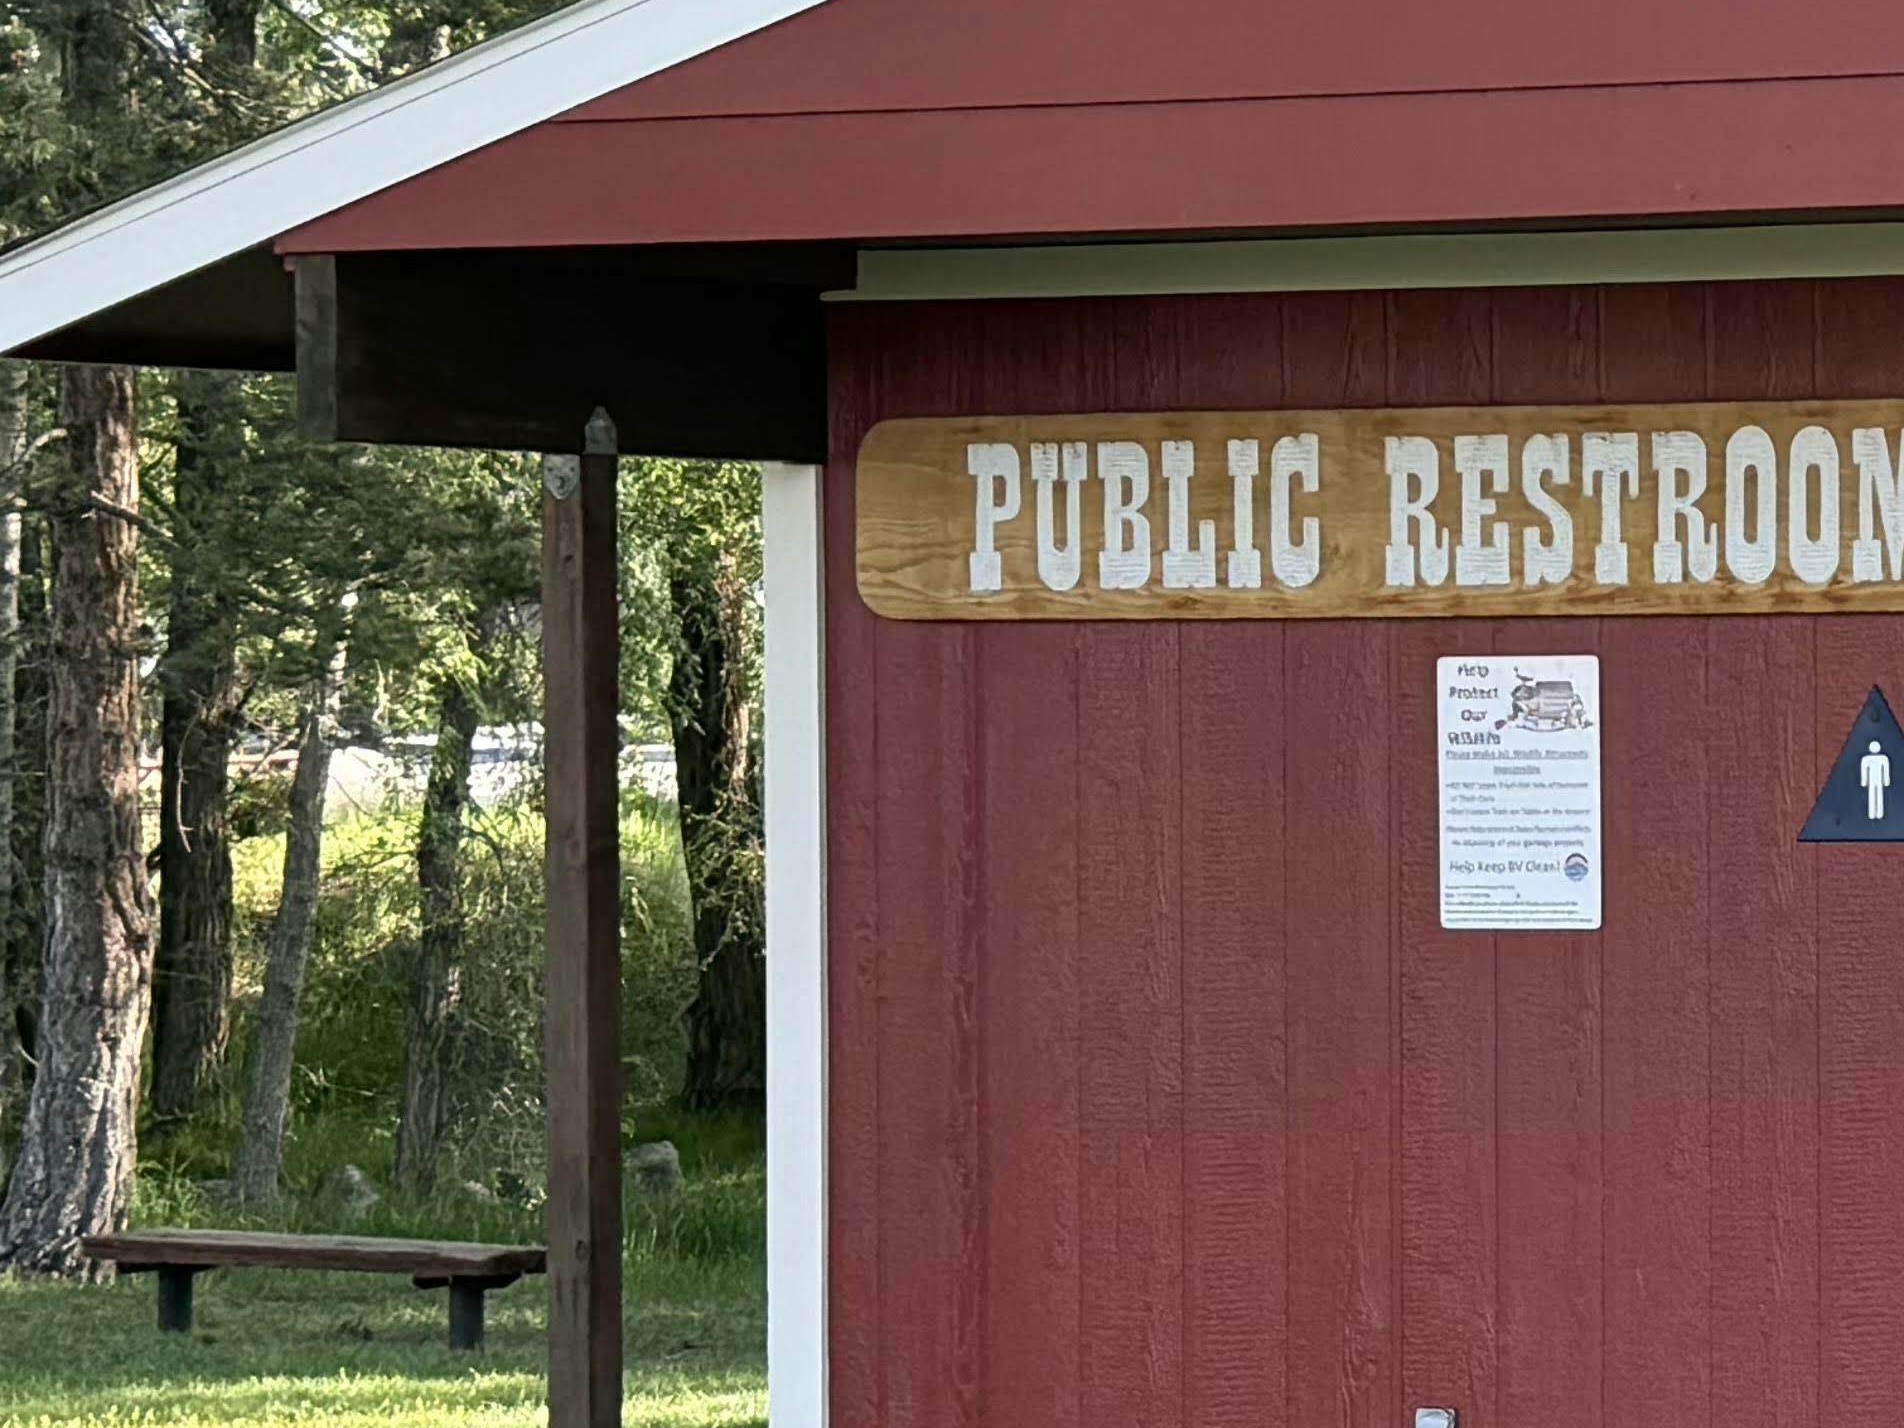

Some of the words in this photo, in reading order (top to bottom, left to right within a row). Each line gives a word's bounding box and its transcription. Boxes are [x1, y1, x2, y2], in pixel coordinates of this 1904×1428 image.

[967, 433, 1320, 591] PUBLIC
[1457, 664, 1489, 678] Help
[1448, 686, 1498, 700] Protect
[1461, 709, 1488, 722] Our
[1449, 860, 1475, 873] Help
[1478, 860, 1506, 873] Keep
[1508, 860, 1524, 872] BV
